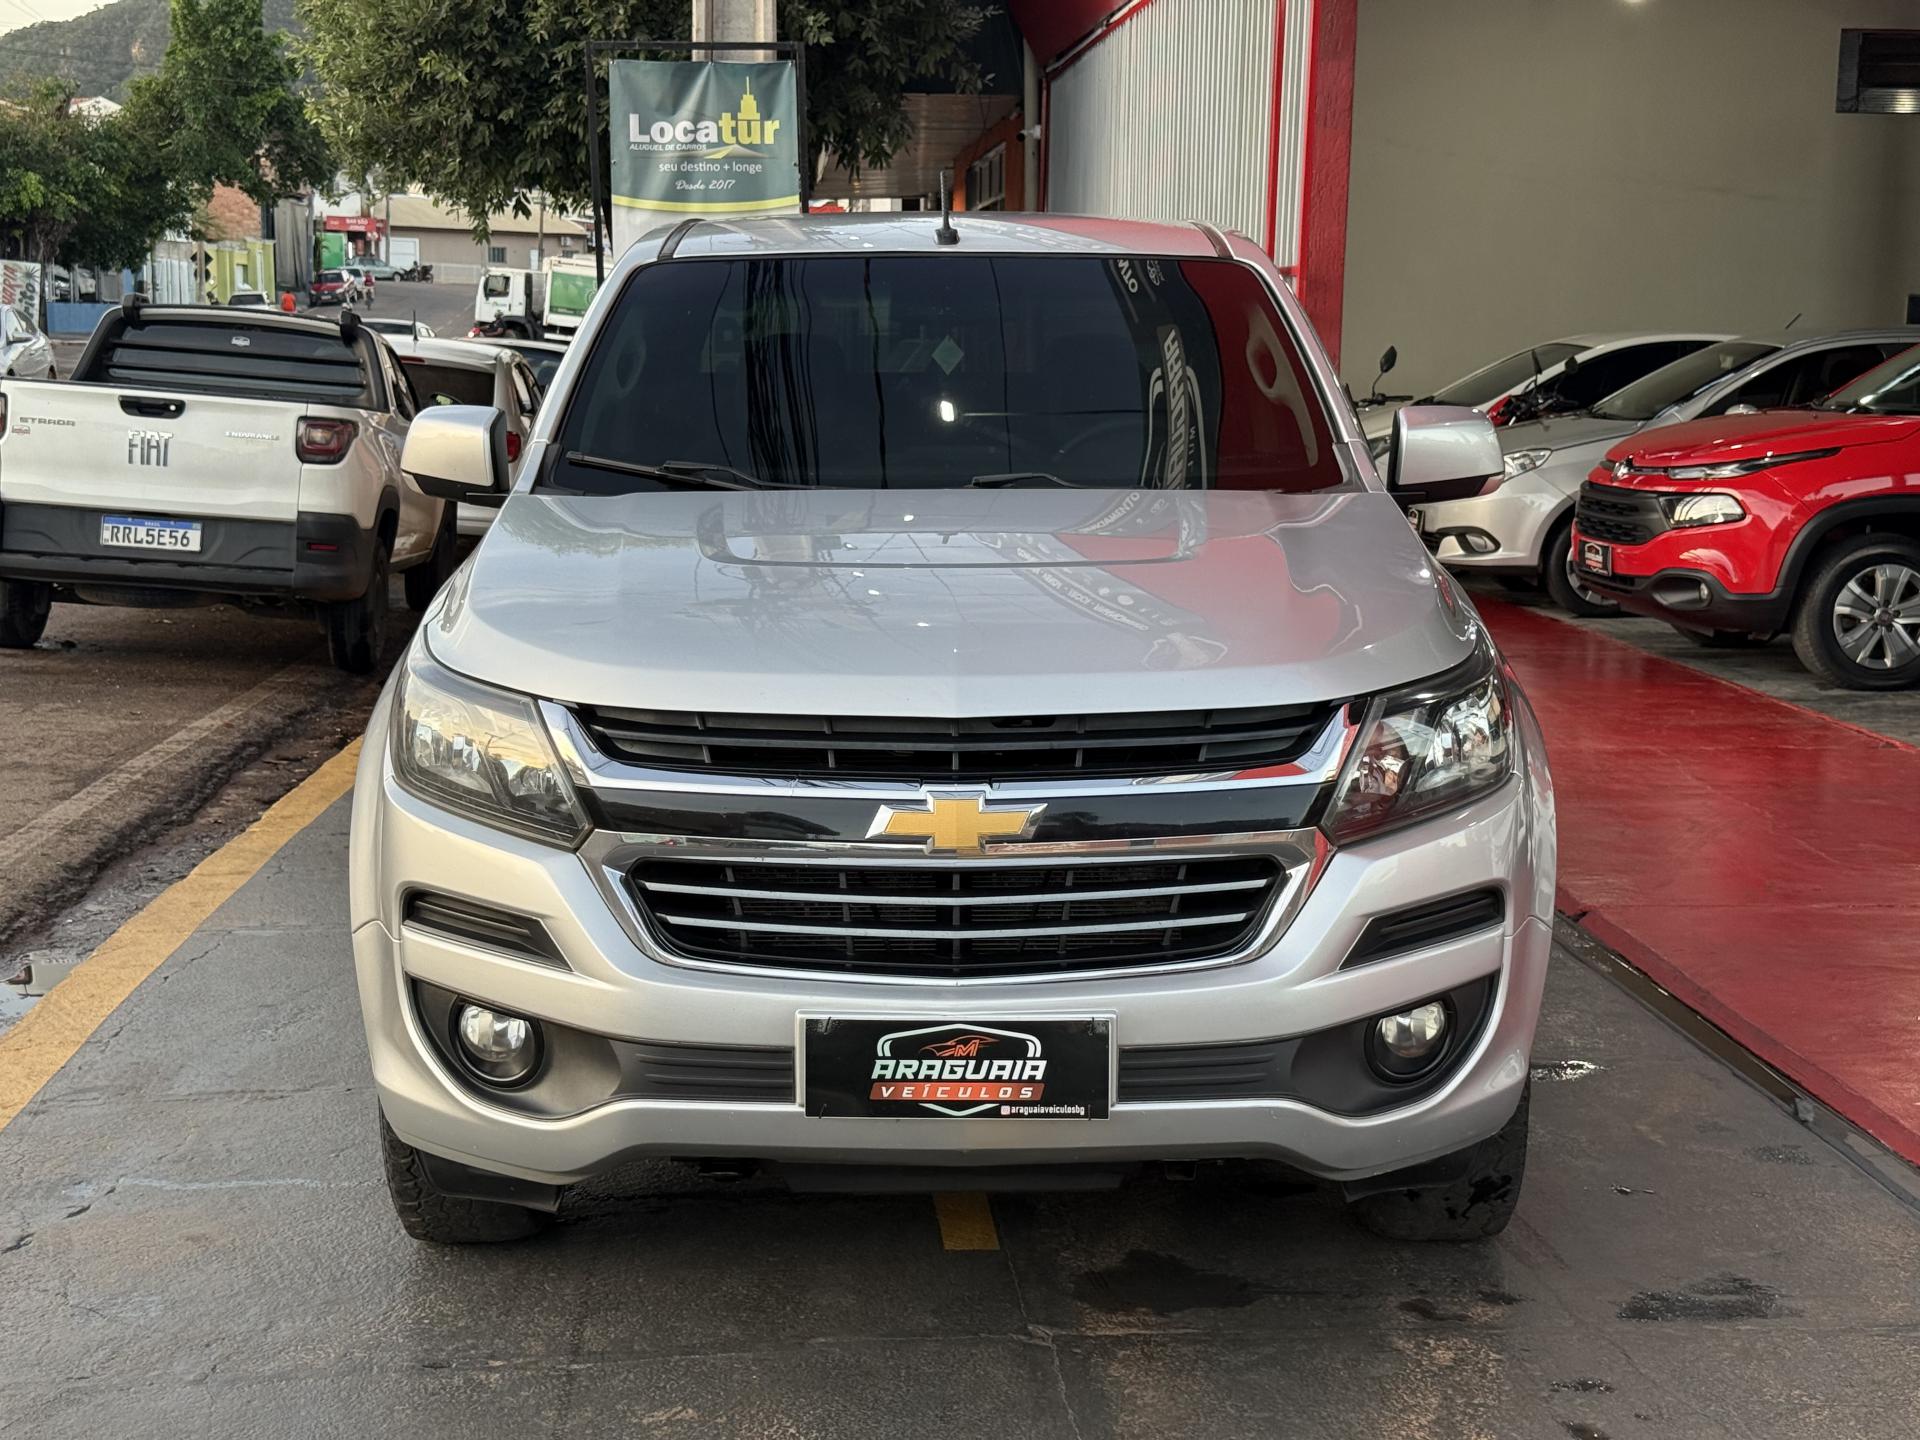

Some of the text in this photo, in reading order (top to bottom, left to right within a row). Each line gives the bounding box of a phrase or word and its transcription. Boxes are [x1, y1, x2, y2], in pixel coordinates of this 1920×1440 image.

[629, 112, 780, 145] Locatur
[659, 163, 678, 172] seu
[680, 161, 721, 172] destino
[732, 161, 763, 174] longe
[675, 179, 736, 190] Desde 2017
[19, 416, 76, 427] STRADA
[128, 429, 173, 467] FIAT
[110, 525, 190, 548] RRL5E56
[870, 1059, 1048, 1081] ARAGUAIA
[880, 1083, 1034, 1099] VEÍCULOS
[1011, 1104, 1085, 1116] araguaiaveiculosbg
